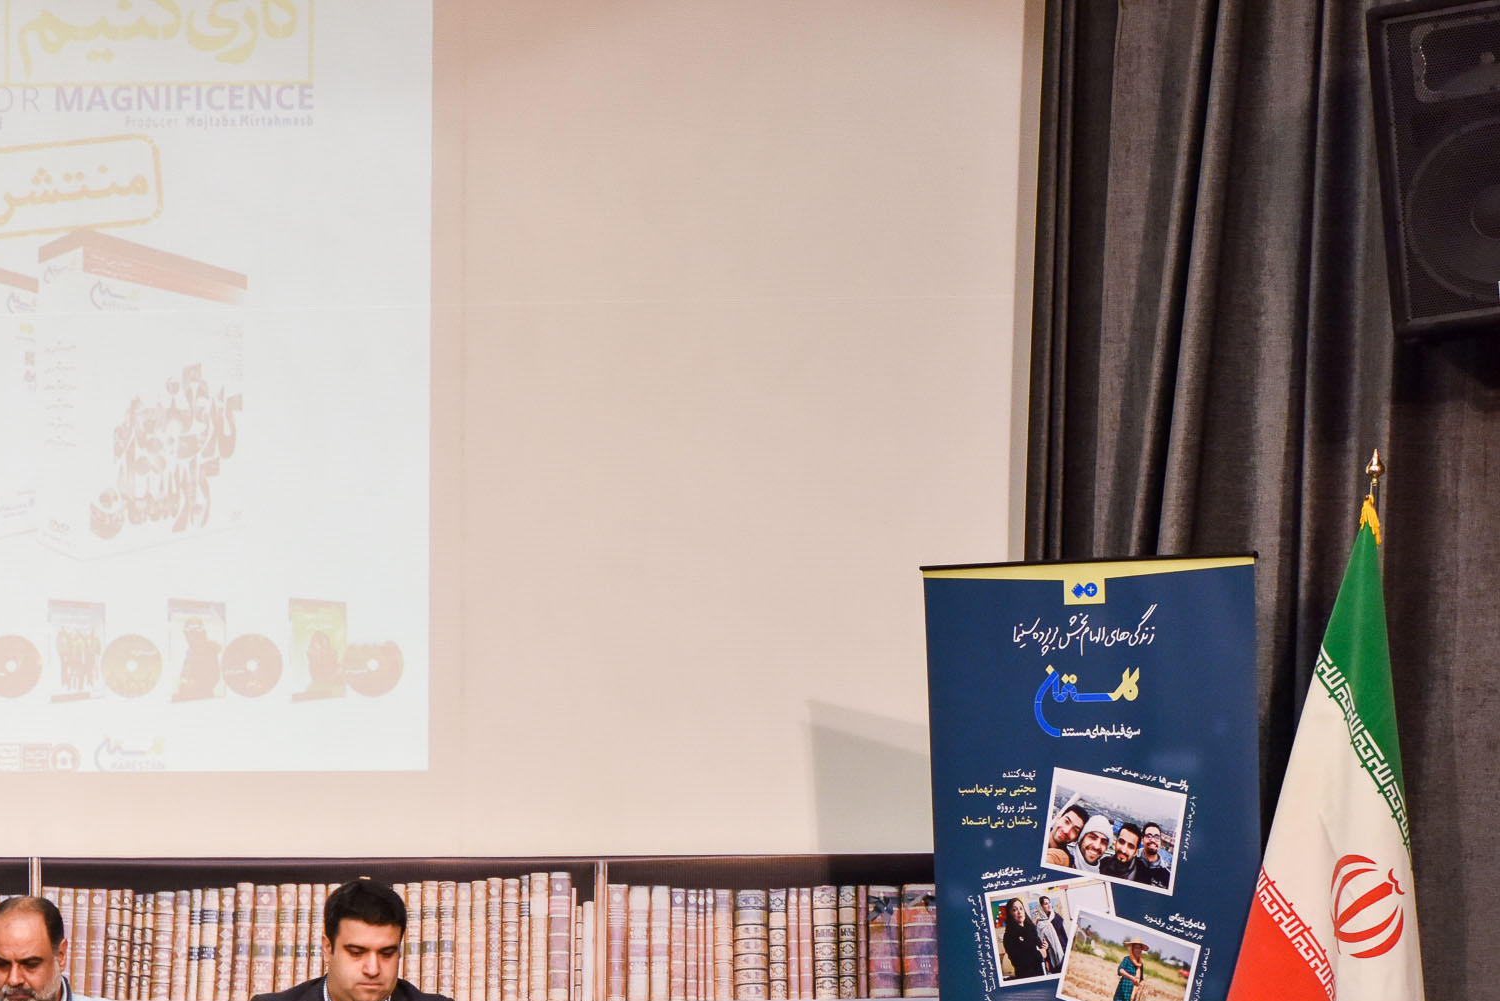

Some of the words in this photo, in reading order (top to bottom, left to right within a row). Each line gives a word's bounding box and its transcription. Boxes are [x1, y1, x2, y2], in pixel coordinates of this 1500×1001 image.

[54, 85, 315, 112] MAGNIFICENCE
[1061, 727, 1090, 737] مستند
[1009, 784, 1037, 797] مجتبی
[996, 802, 1015, 814] پروژه
[1017, 801, 1038, 813] مشاور
[1006, 815, 1038, 829] رخشان
[1011, 876, 1027, 886] محسن
